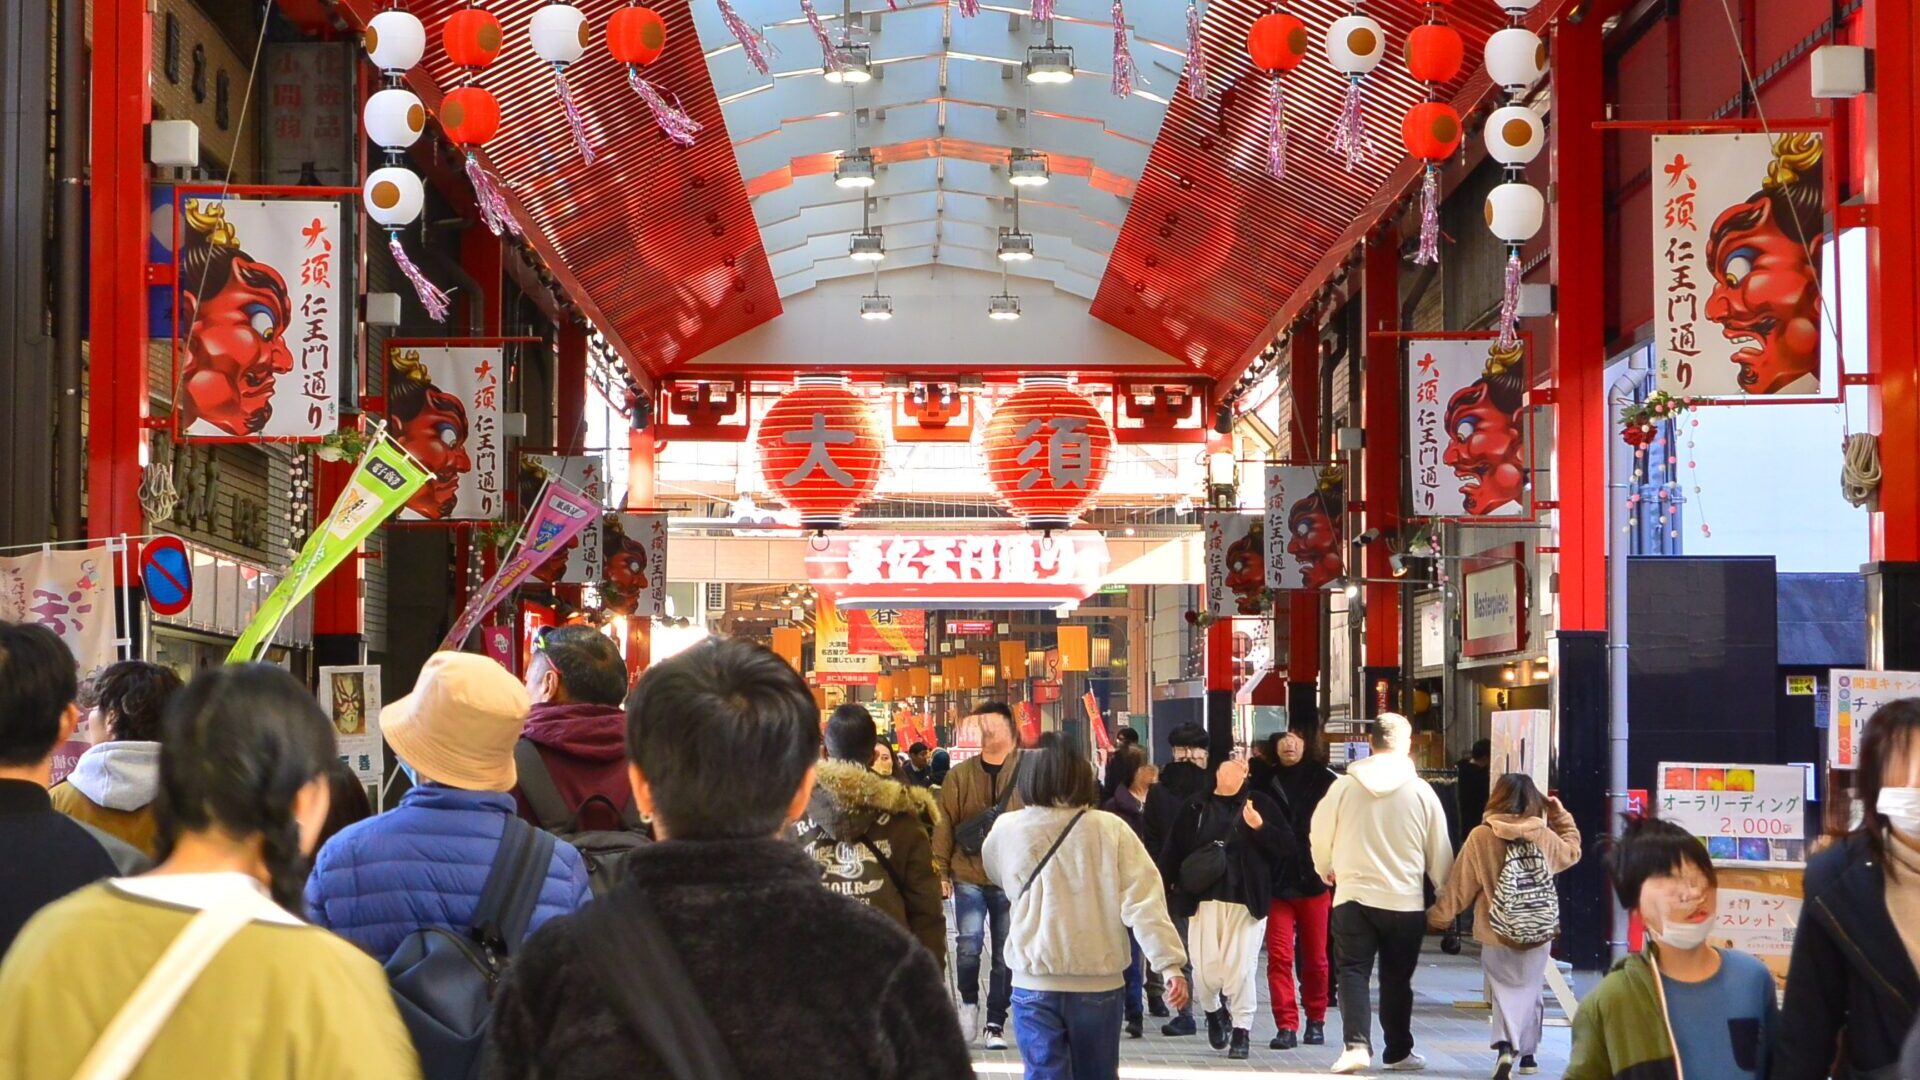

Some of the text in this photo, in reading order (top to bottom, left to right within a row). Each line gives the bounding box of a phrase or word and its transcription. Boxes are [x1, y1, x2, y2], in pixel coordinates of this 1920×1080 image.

[300, 217, 331, 430] 大須仁王門通り
[1663, 153, 1701, 390] 大須仁王門通り
[472, 359, 497, 513] 大須仁王門通り
[783, 412, 1092, 491] 大 須
[1415, 351, 1441, 512] 大須仁王門通り
[582, 463, 598, 579] 大須王門通り
[651, 519, 664, 612] 大須仁王門通り
[1208, 520, 1224, 615] 大須仁王門通り
[1267, 474, 1288, 587] 大須仁王門通り
[1474, 592, 1509, 622] Masterpiece
[1663, 794, 1800, 814] オーラリーディング
[1716, 912, 1775, 928] スレット
